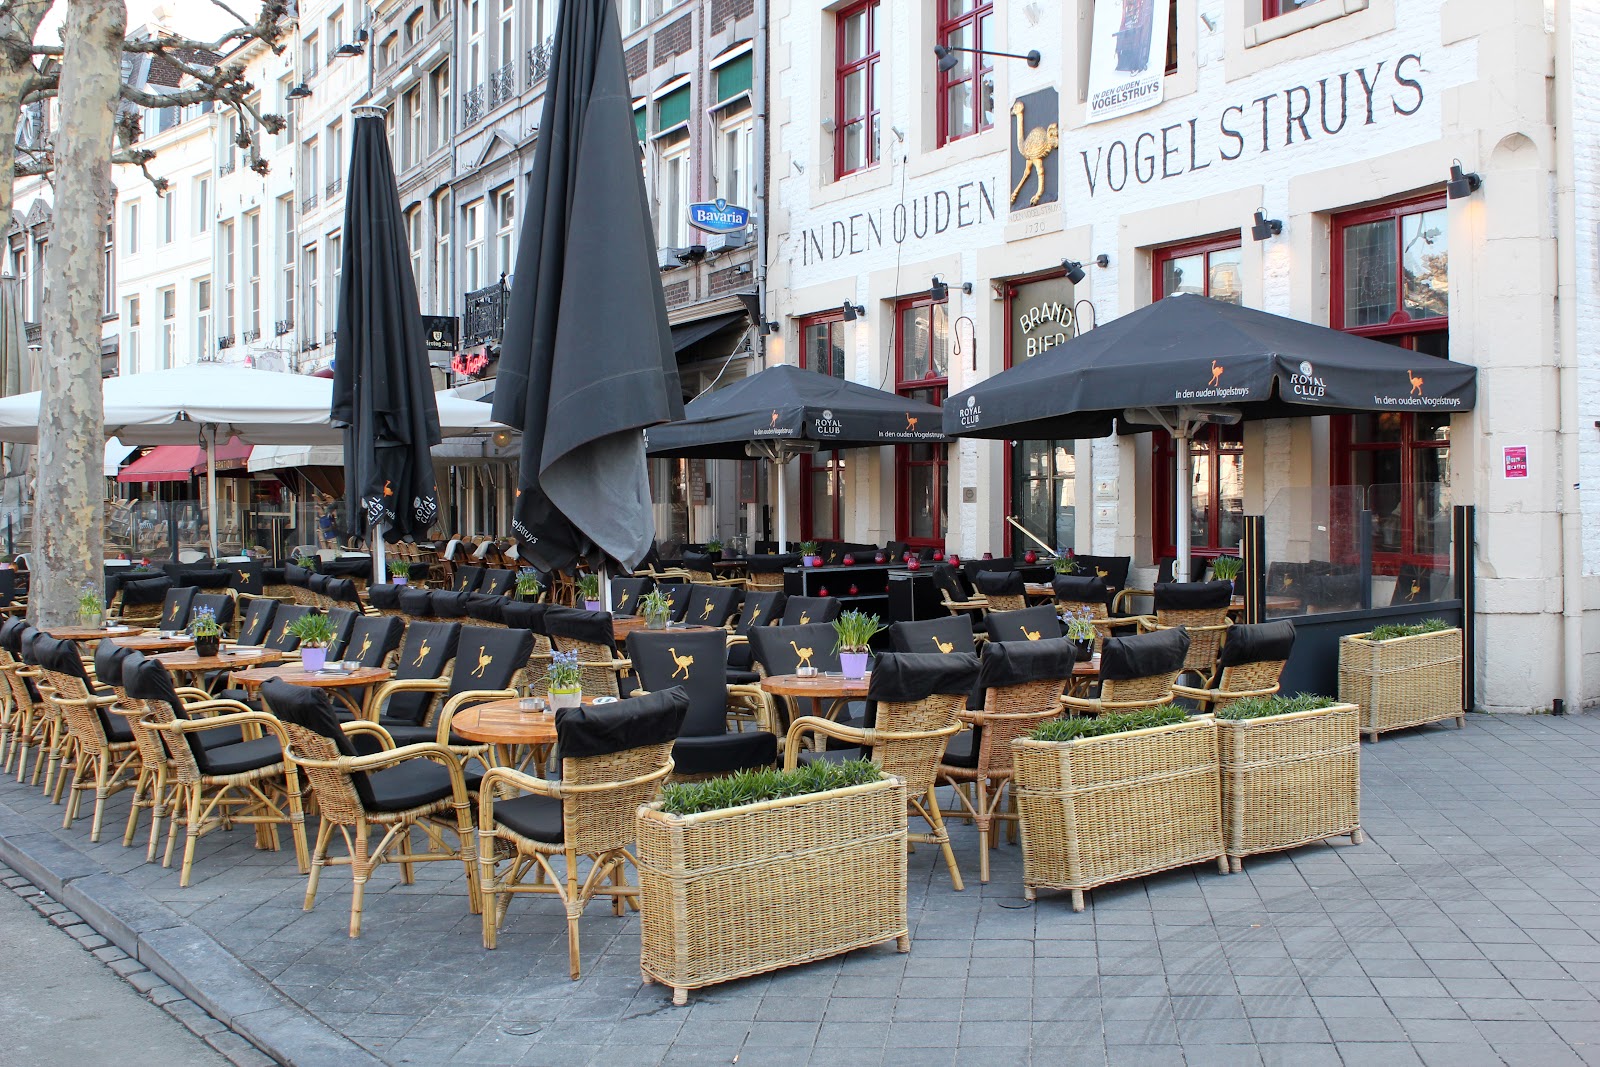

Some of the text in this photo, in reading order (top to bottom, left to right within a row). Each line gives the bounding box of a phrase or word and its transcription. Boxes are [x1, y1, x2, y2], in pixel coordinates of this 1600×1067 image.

[1092, 80, 1140, 101] IN DEN OUDEN
[1092, 81, 1159, 111] VOGELSTRUYS
[802, 53, 1424, 266] IN DEN OUDEN VOGELSTRUYS
[697, 210, 743, 225] Bavaria
[1020, 301, 1072, 335] BRAND
[1290, 373, 1327, 387] ROYAL
[1175, 386, 1249, 399] In den ouden Vogelstruys
[1294, 384, 1325, 397] CLUB
[1374, 395, 1461, 407] In den ouden Vogelstruys
[959, 405, 982, 418] ROYAL
[815, 418, 842, 427] ROYAL
[961, 414, 980, 426] CLUB
[817, 426, 840, 434] CLUB
[420, 502, 437, 524] CLUB
